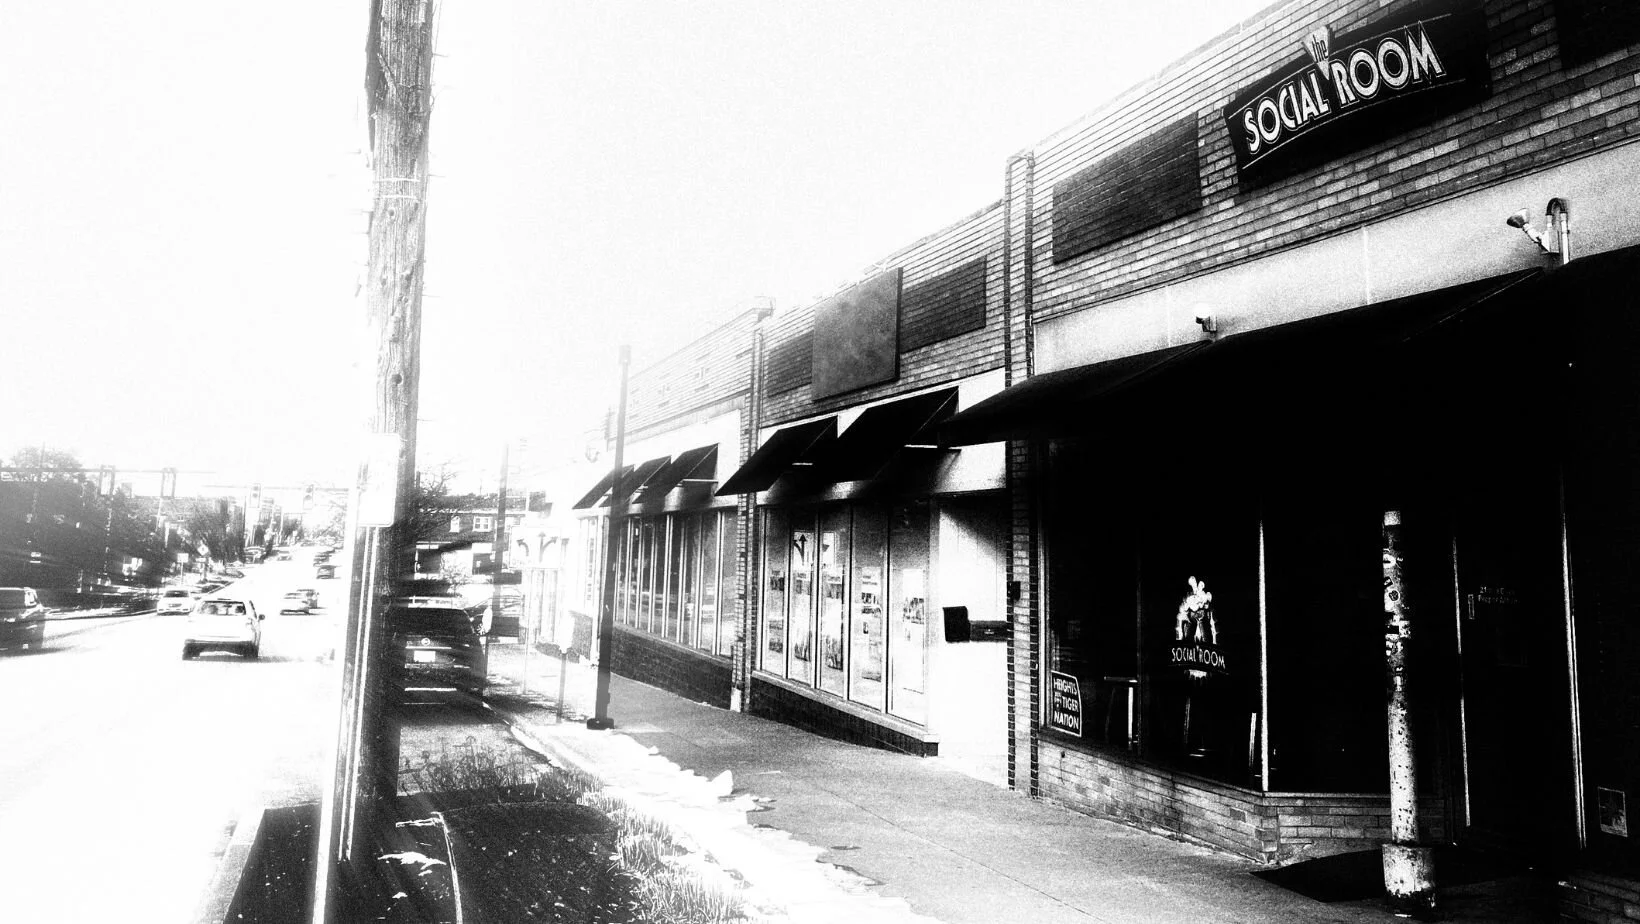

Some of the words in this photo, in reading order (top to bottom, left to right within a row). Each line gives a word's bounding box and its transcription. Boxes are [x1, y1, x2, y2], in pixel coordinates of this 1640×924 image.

[1311, 33, 1329, 63] the
[1244, 69, 1331, 154] SOCIAL
[1329, 20, 1447, 109] ROOM
[1171, 646, 1196, 662] SOCIAL
[1198, 648, 1226, 669] ROOM
[1053, 677, 1078, 696] HEIGHTS
[1062, 695, 1079, 712] TIGER
[1053, 710, 1079, 730] NATION
